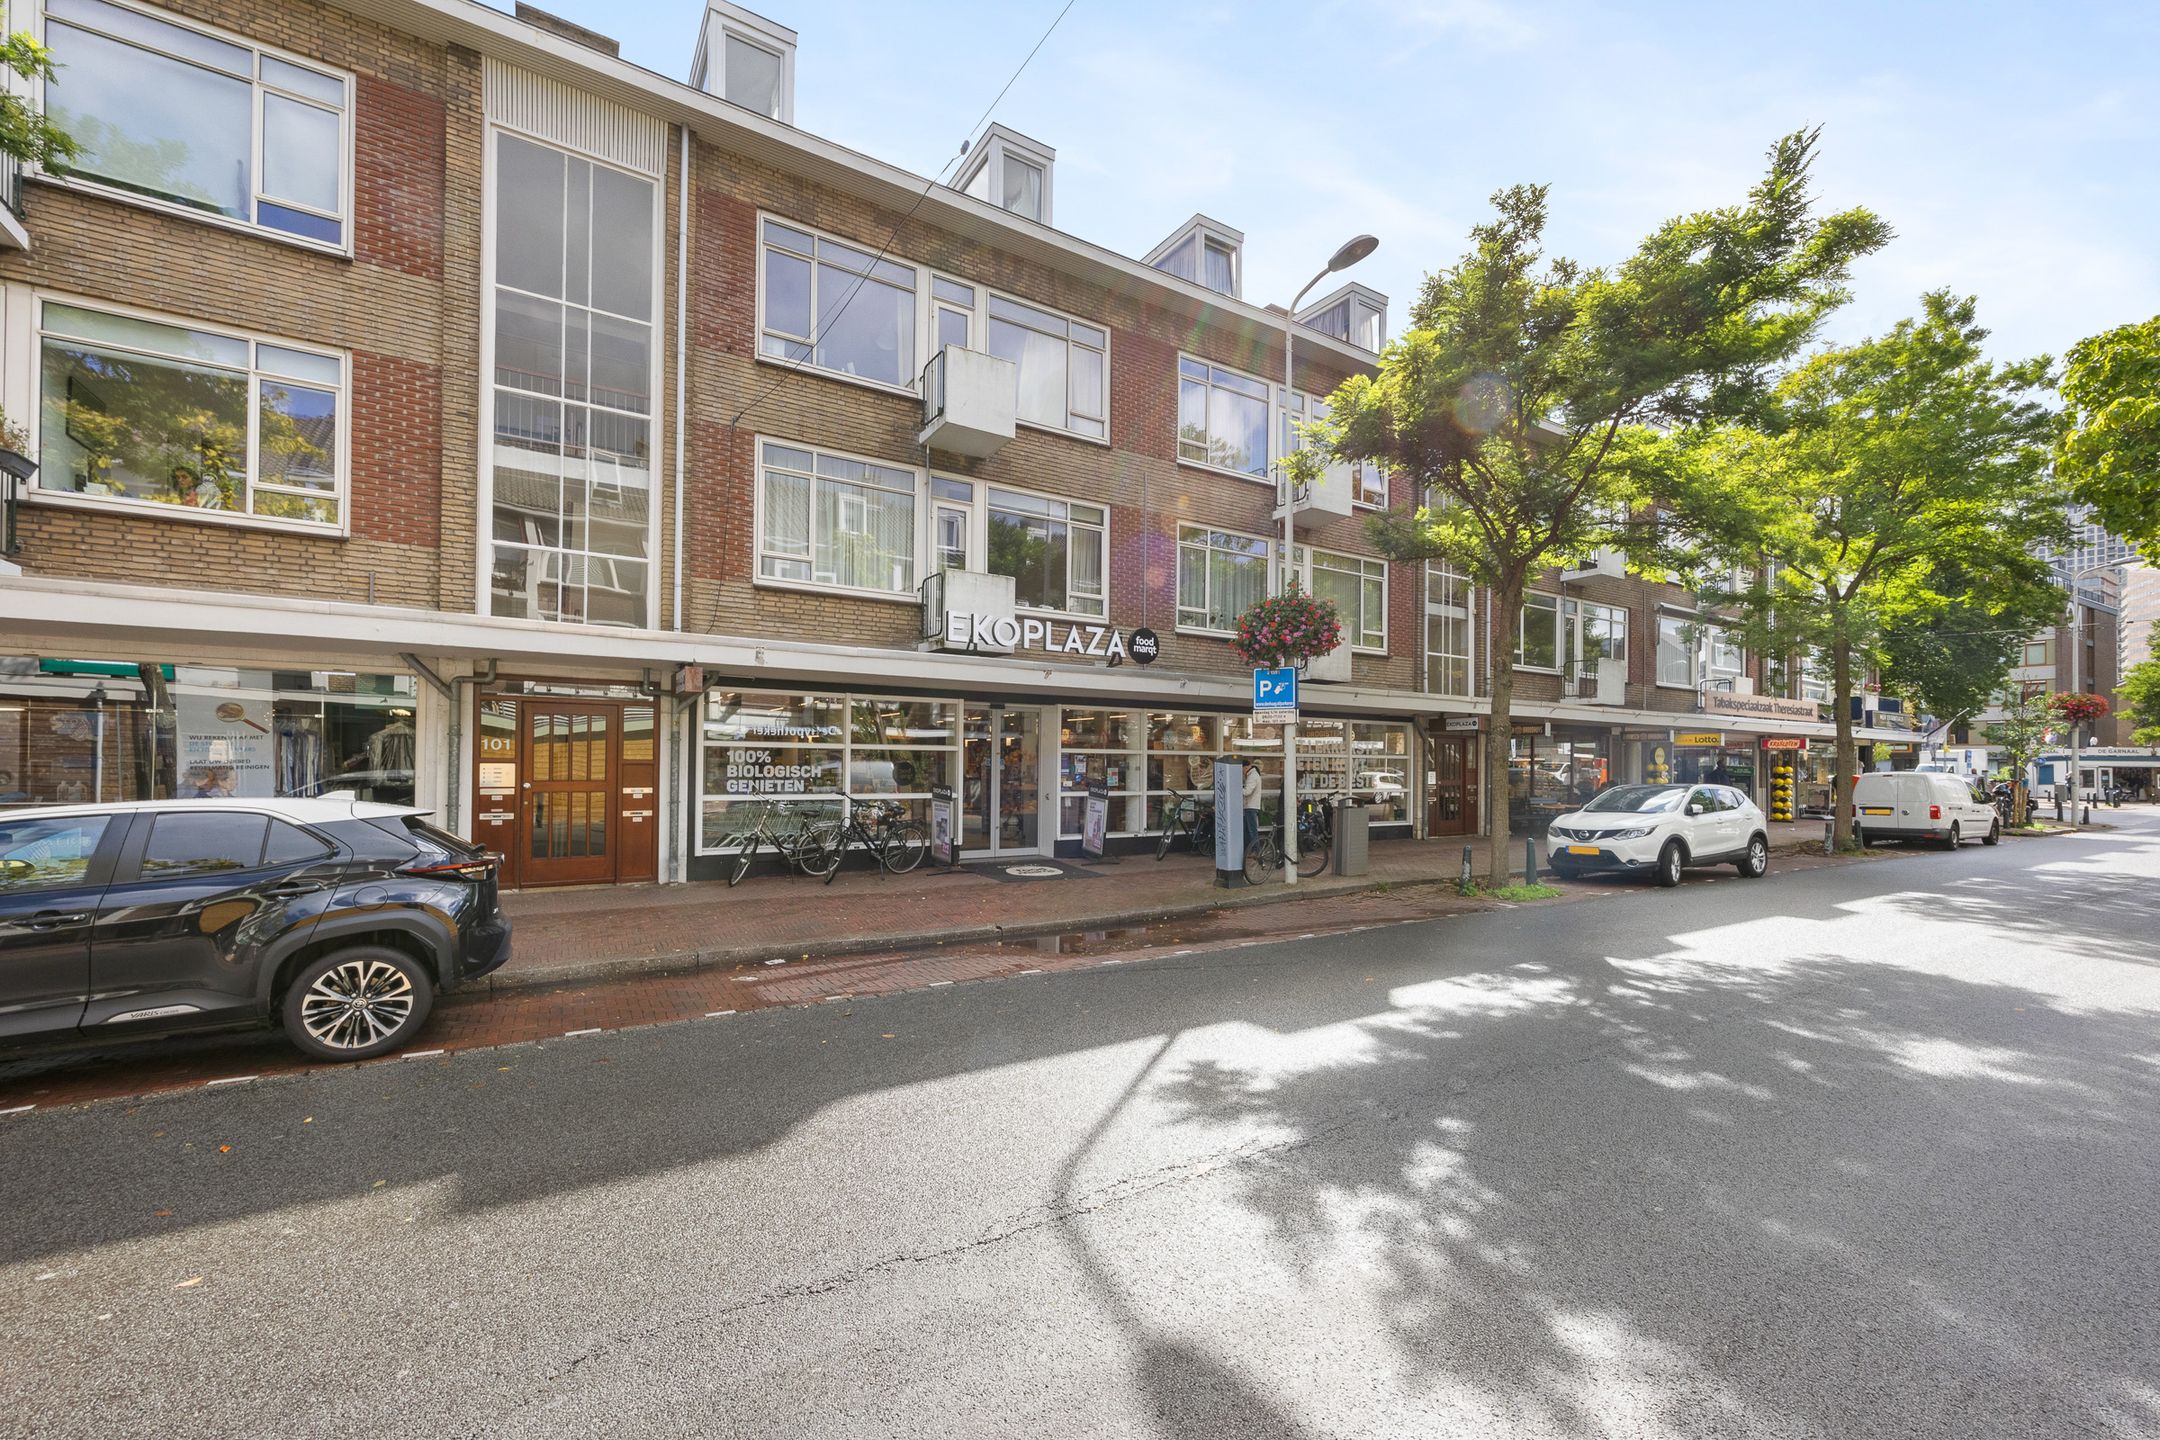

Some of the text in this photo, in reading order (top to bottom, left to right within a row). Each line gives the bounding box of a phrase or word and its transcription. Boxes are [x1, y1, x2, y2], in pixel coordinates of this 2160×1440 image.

[947, 611, 1126, 657] EKOPLAZA
[1135, 635, 1155, 647] food
[1133, 645, 1157, 656] marqt
[1260, 680, 1272, 697] P
[1713, 696, 1814, 717] Tabakspeciaalzaak Theresiastraat
[481, 738, 511, 751] 101
[727, 750, 772, 763] 100%
[727, 765, 822, 778] BIOLOGISCH
[726, 779, 805, 792] GENIETEN
